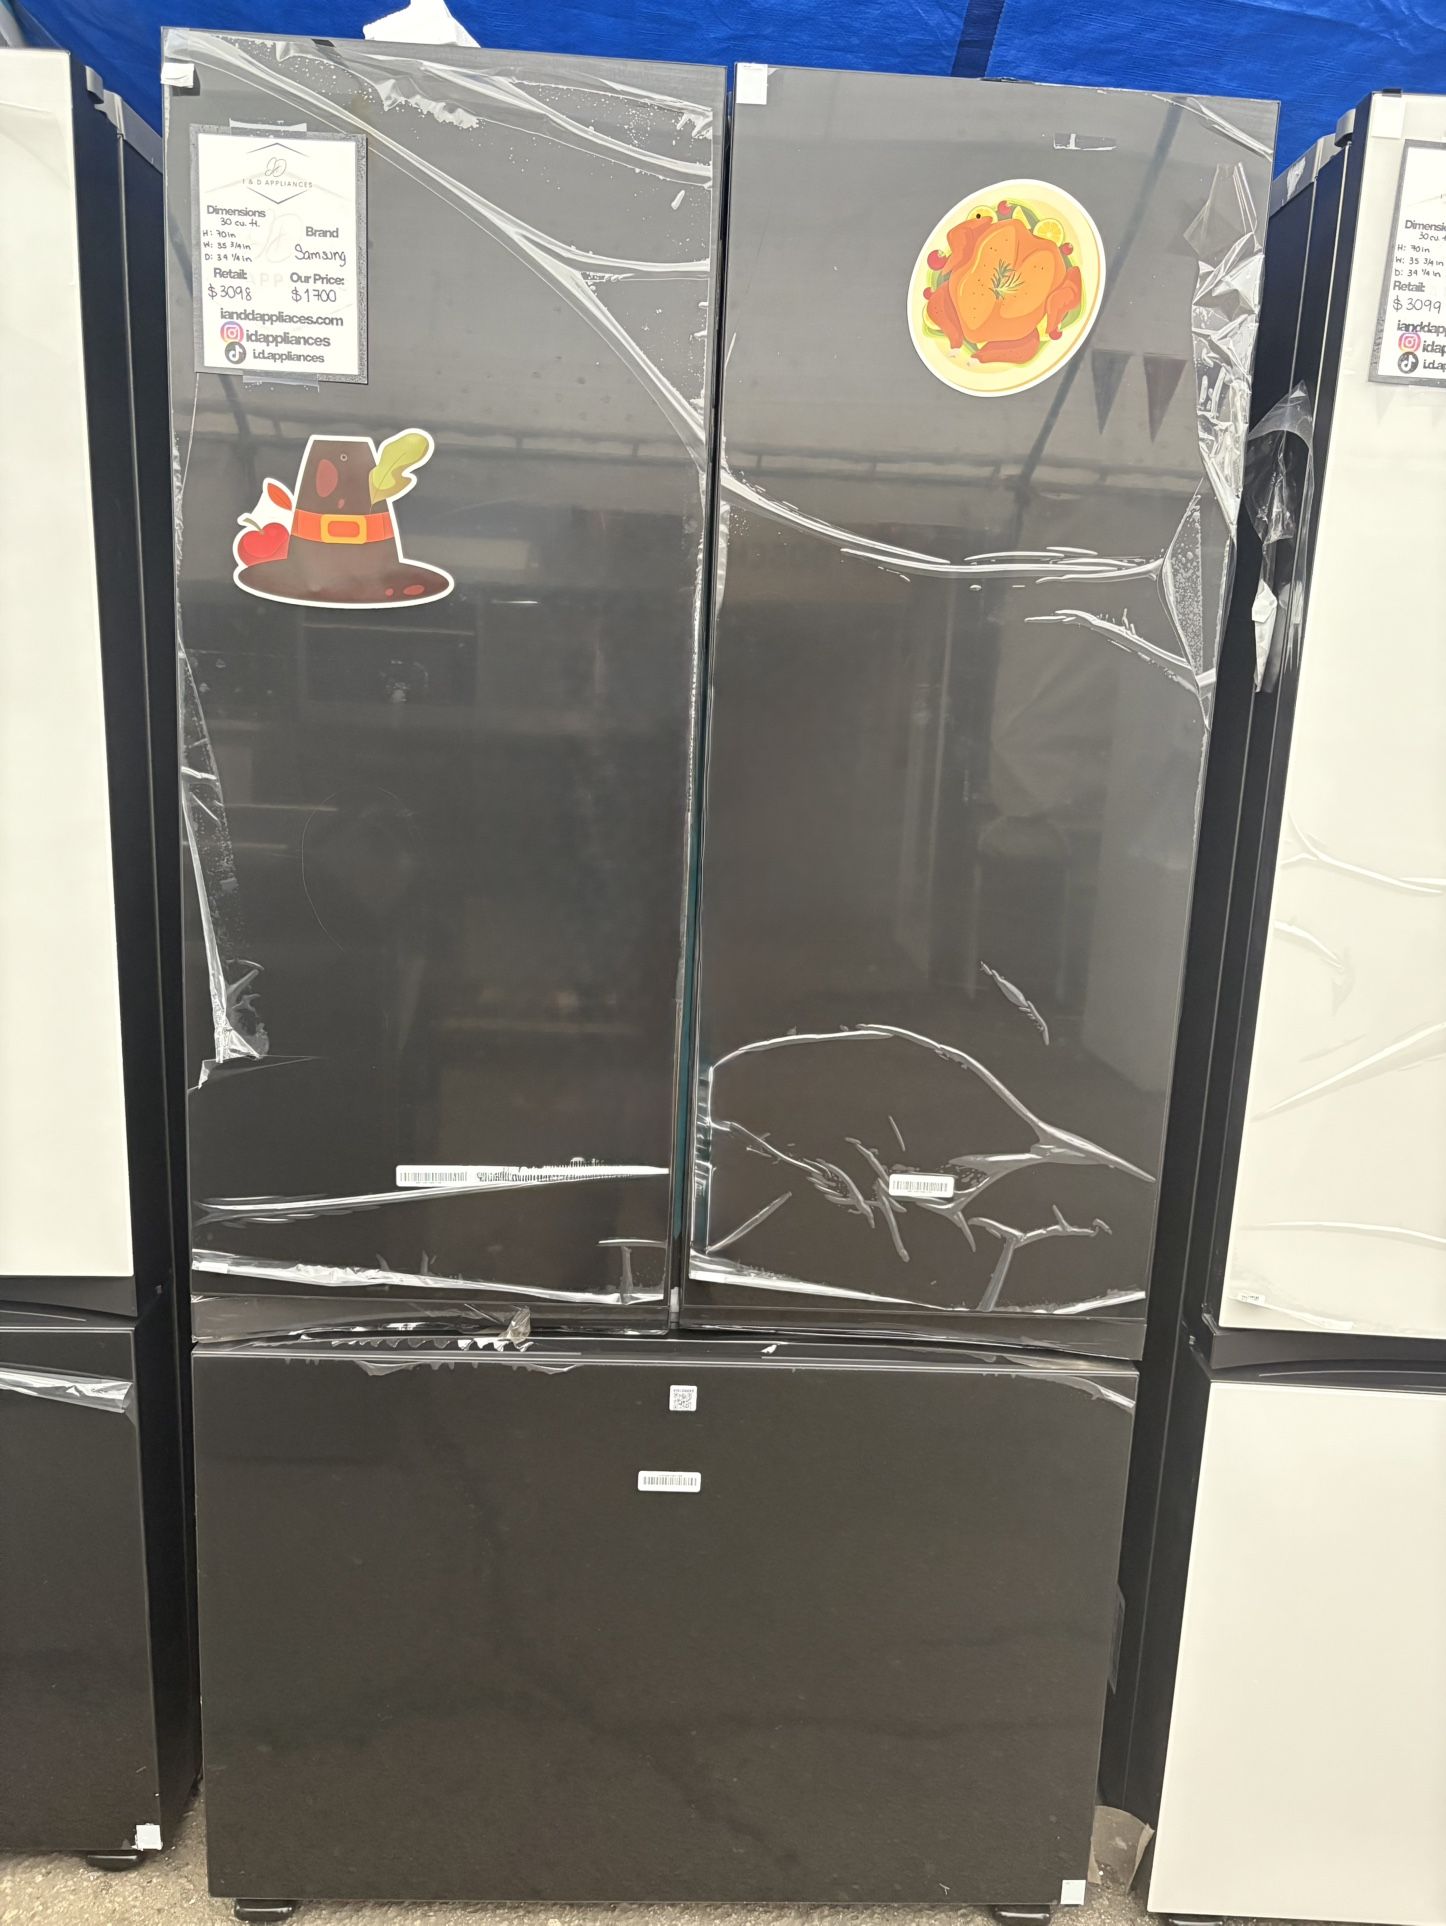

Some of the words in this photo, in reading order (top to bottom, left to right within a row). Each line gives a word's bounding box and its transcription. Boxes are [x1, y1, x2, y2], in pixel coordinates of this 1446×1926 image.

[264, 180, 314, 189] APPLIANCES
[207, 205, 266, 218] Dimensions
[220, 217, 232, 226] 30
[305, 226, 340, 239] Brand
[1418, 231, 1429, 240] 30
[294, 243, 347, 267] Samsung
[213, 267, 248, 280] Retail:
[290, 272, 311, 284] Our
[313, 273, 345, 286] Price:
[1392, 280, 1425, 292] Retail:
[220, 307, 344, 327] ianddappliaces.com
[245, 330, 331, 348] idappliances
